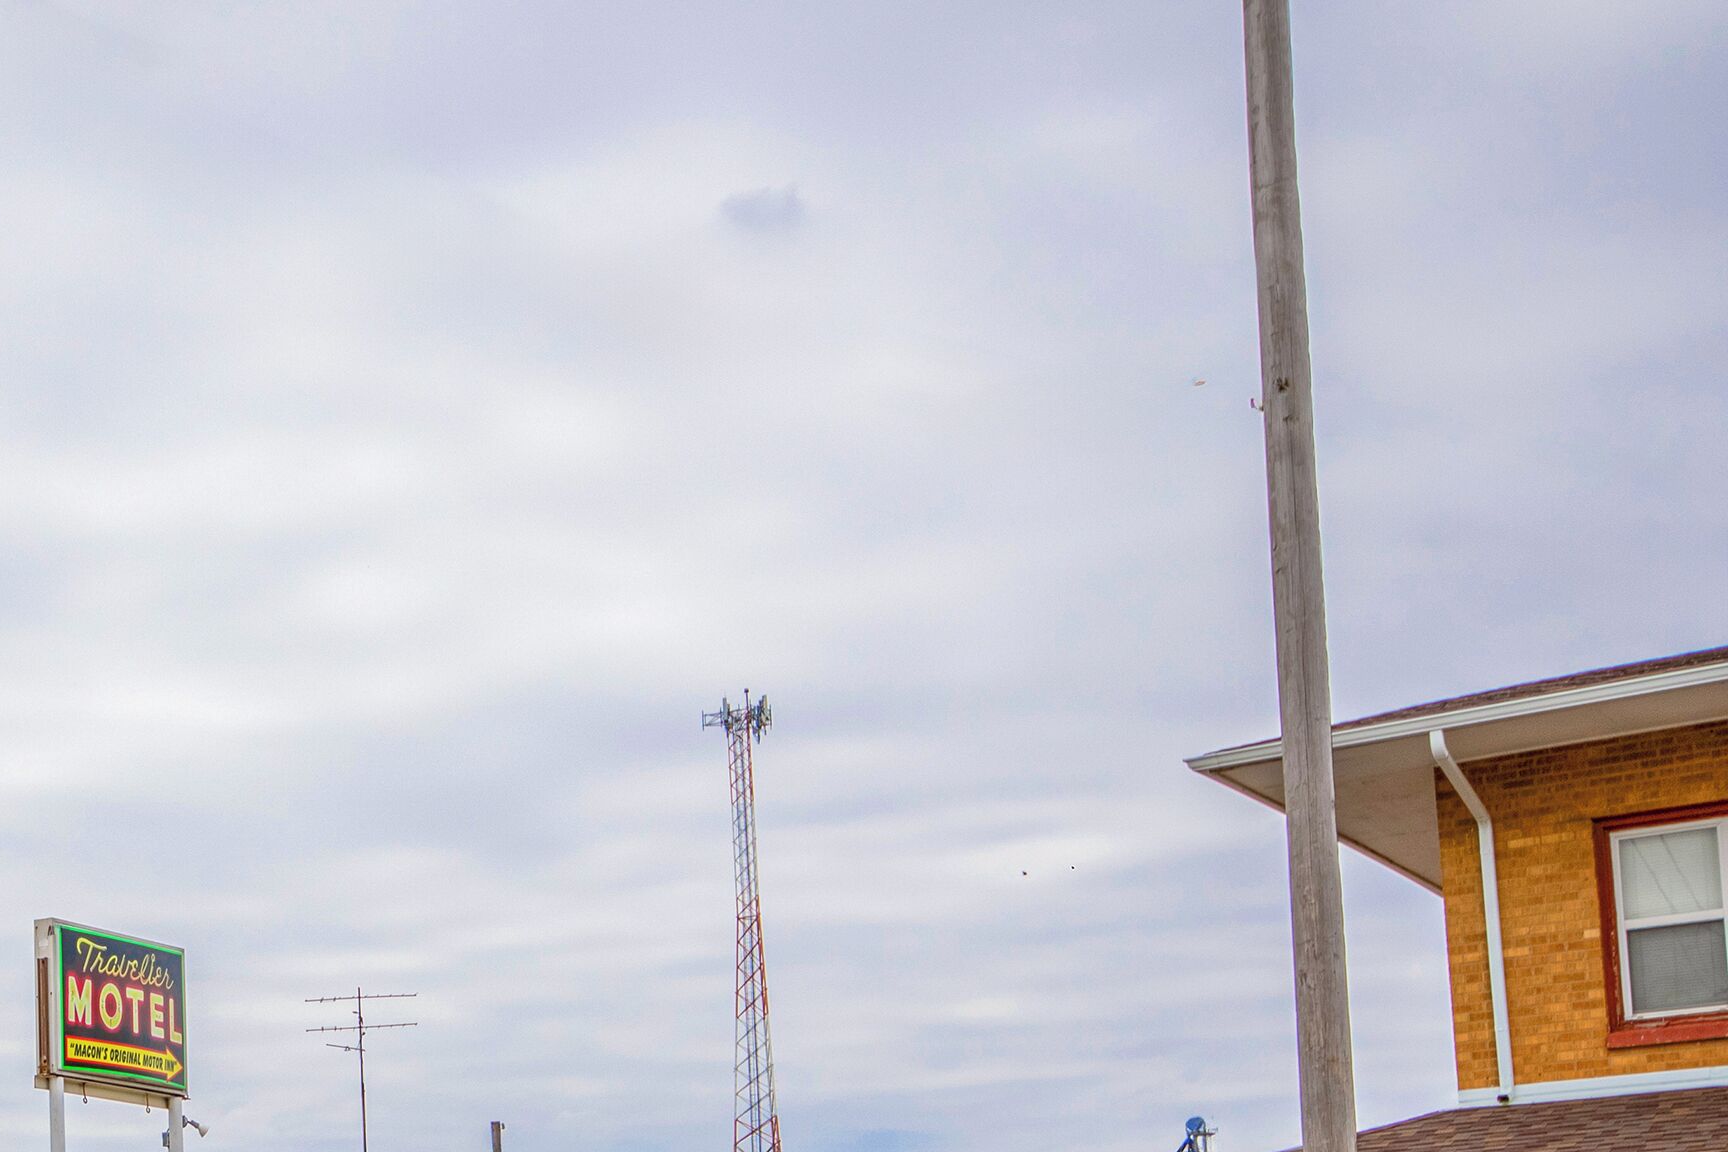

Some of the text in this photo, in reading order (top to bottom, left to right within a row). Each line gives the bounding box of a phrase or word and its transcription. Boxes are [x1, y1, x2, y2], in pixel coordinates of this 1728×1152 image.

[76, 936, 174, 990] Traveller
[68, 975, 182, 1045] MOTEL
[110, 1048, 141, 1066] ORIGINAL
[143, 1054, 164, 1071] MOTOR
